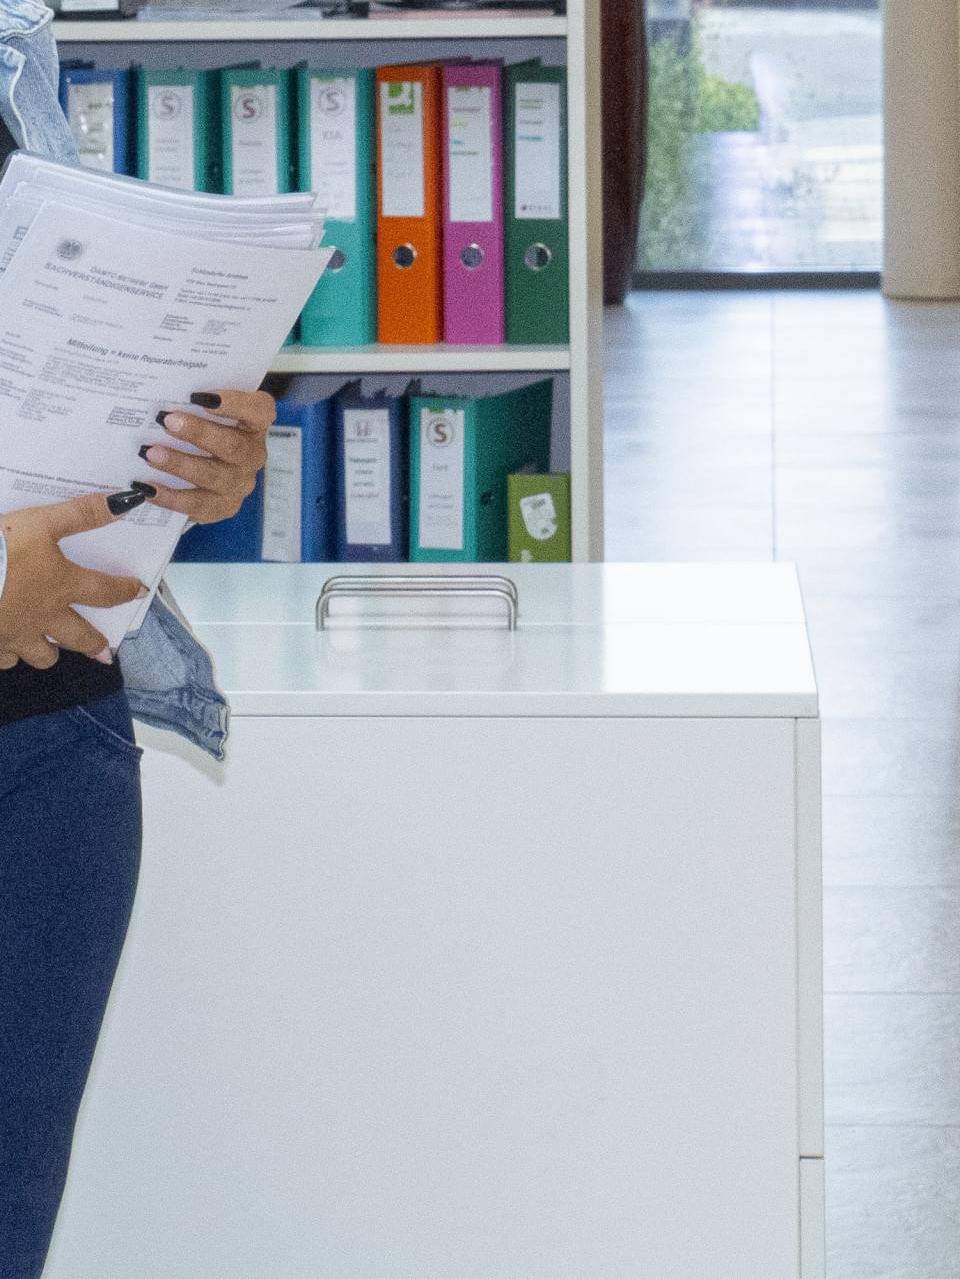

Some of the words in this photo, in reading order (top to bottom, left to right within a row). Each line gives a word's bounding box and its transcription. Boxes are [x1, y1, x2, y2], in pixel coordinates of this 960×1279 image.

[161, 97, 174, 116] S
[242, 98, 256, 119] S
[66, 337, 109, 355] Mitteilung
[117, 350, 139, 361] keine
[433, 423, 447, 443] S
